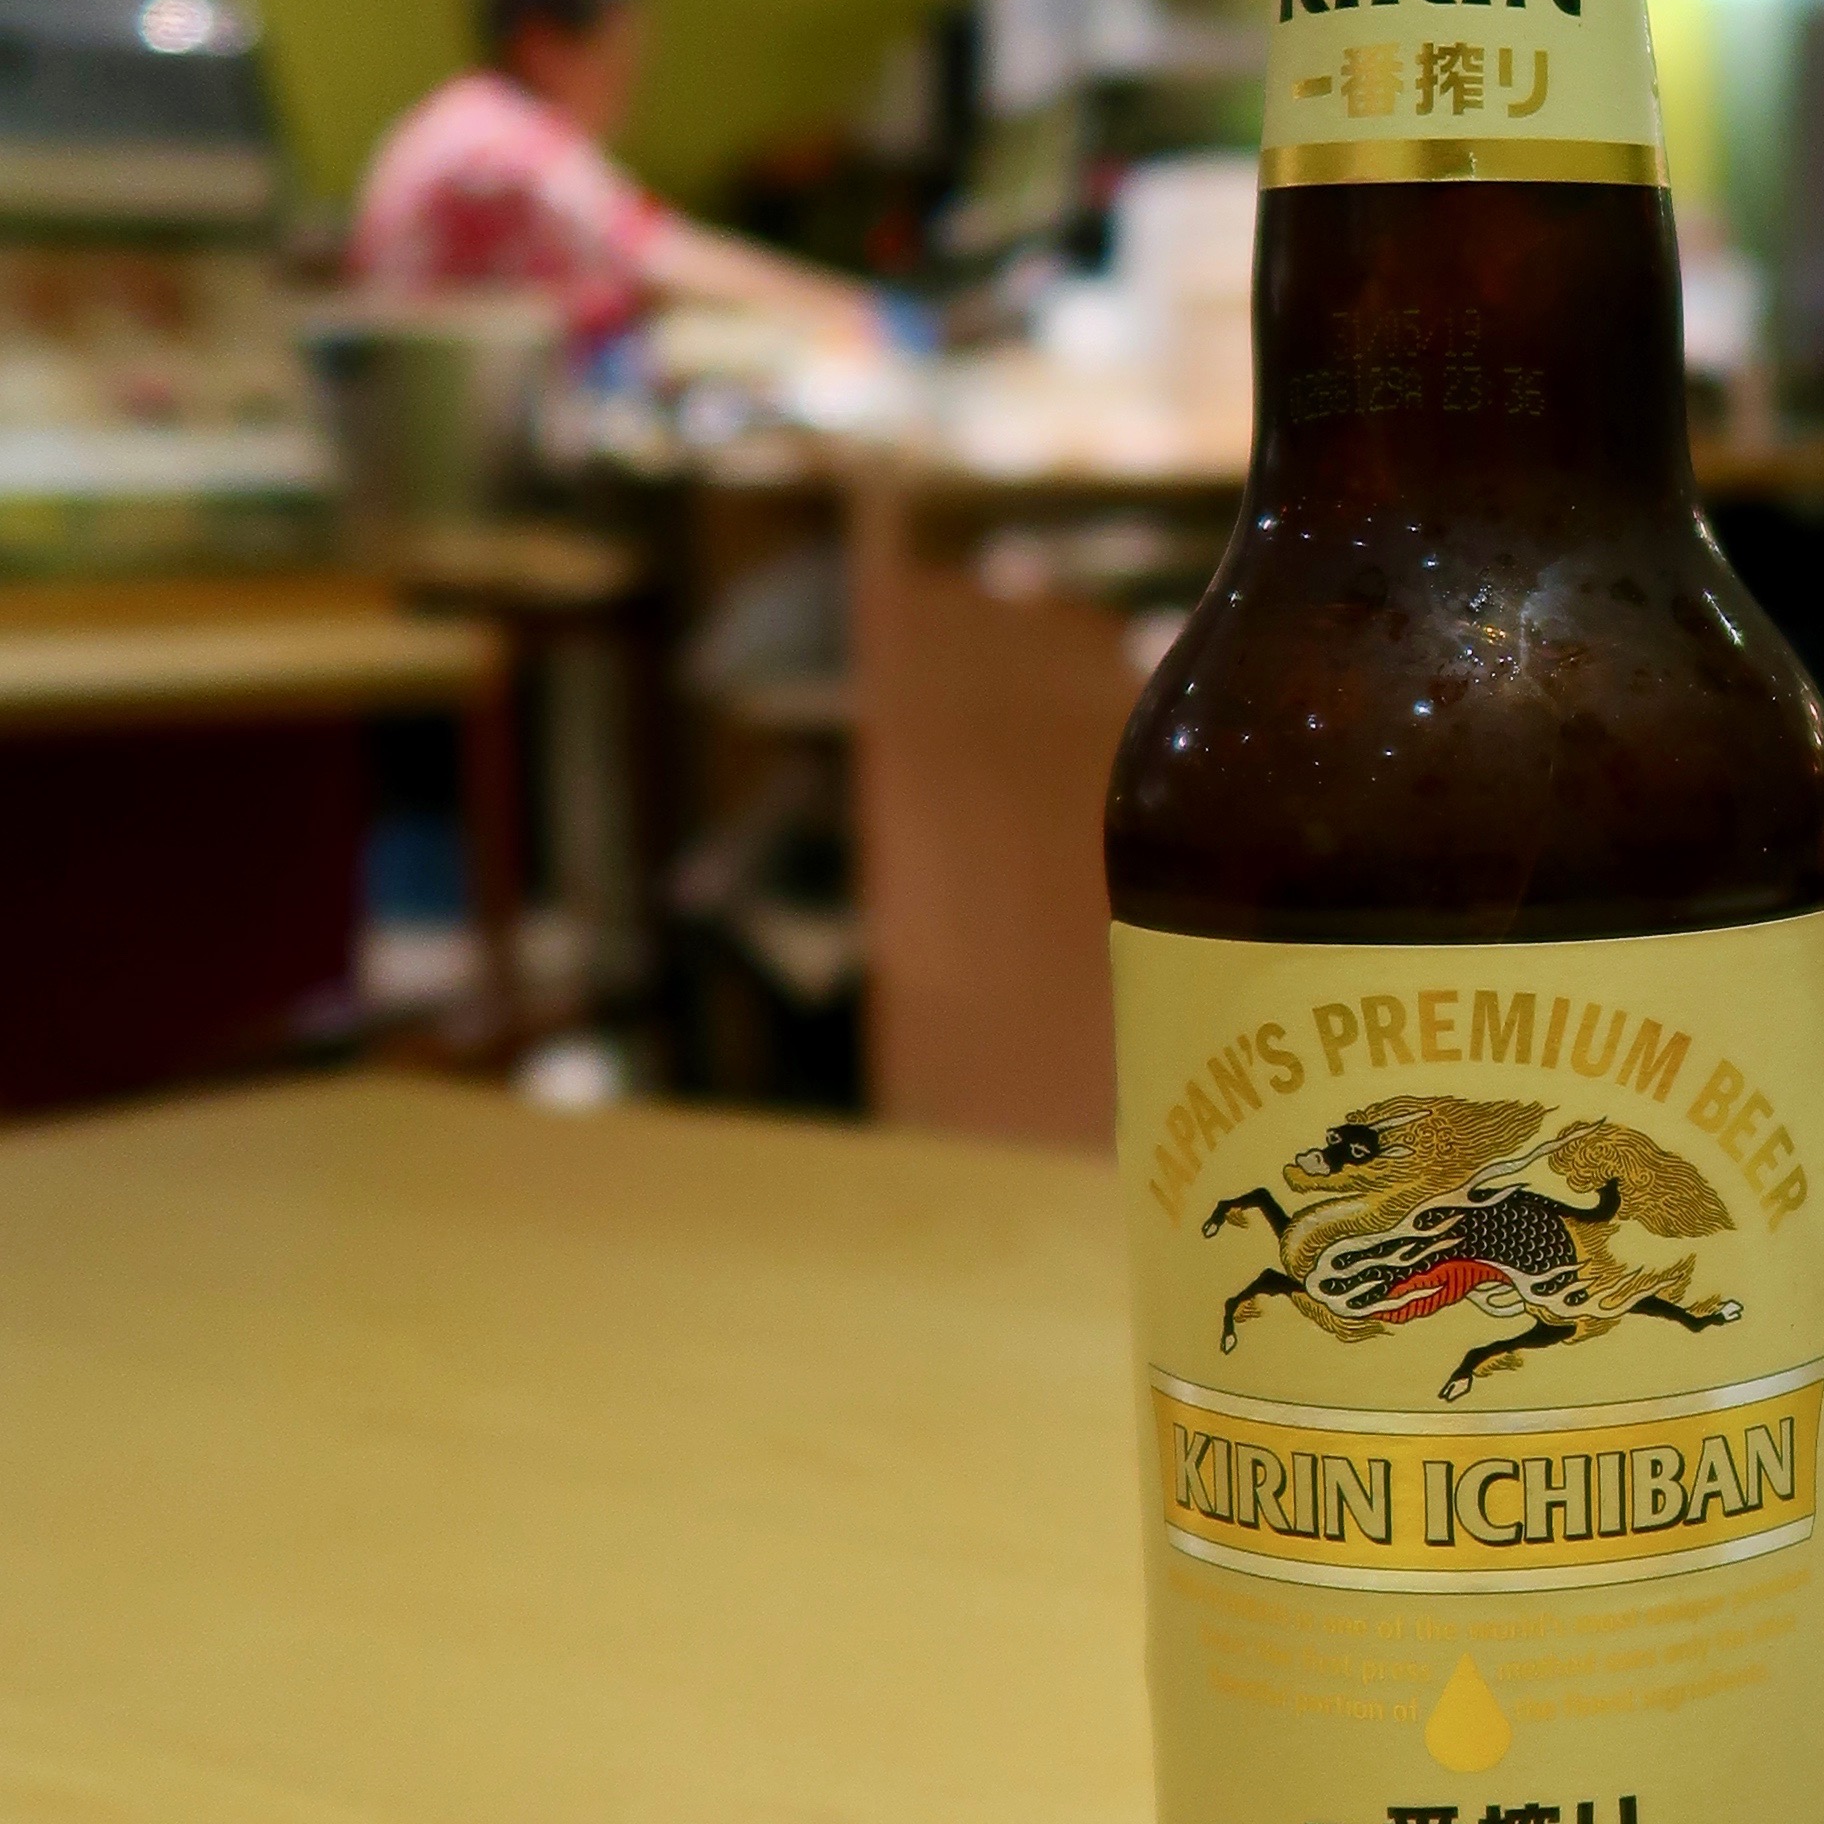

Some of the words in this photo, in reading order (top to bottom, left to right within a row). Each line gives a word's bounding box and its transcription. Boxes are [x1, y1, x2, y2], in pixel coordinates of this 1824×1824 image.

[1292, 41, 1549, 119] 一番搾り
[1149, 1022, 1306, 1231] JAPAN'S
[1312, 989, 1693, 1104] PREMIUM
[1685, 1057, 1810, 1232] BEER
[1172, 1423, 1394, 1544] KIRIN
[1423, 1416, 1796, 1546] ICHIBAN
